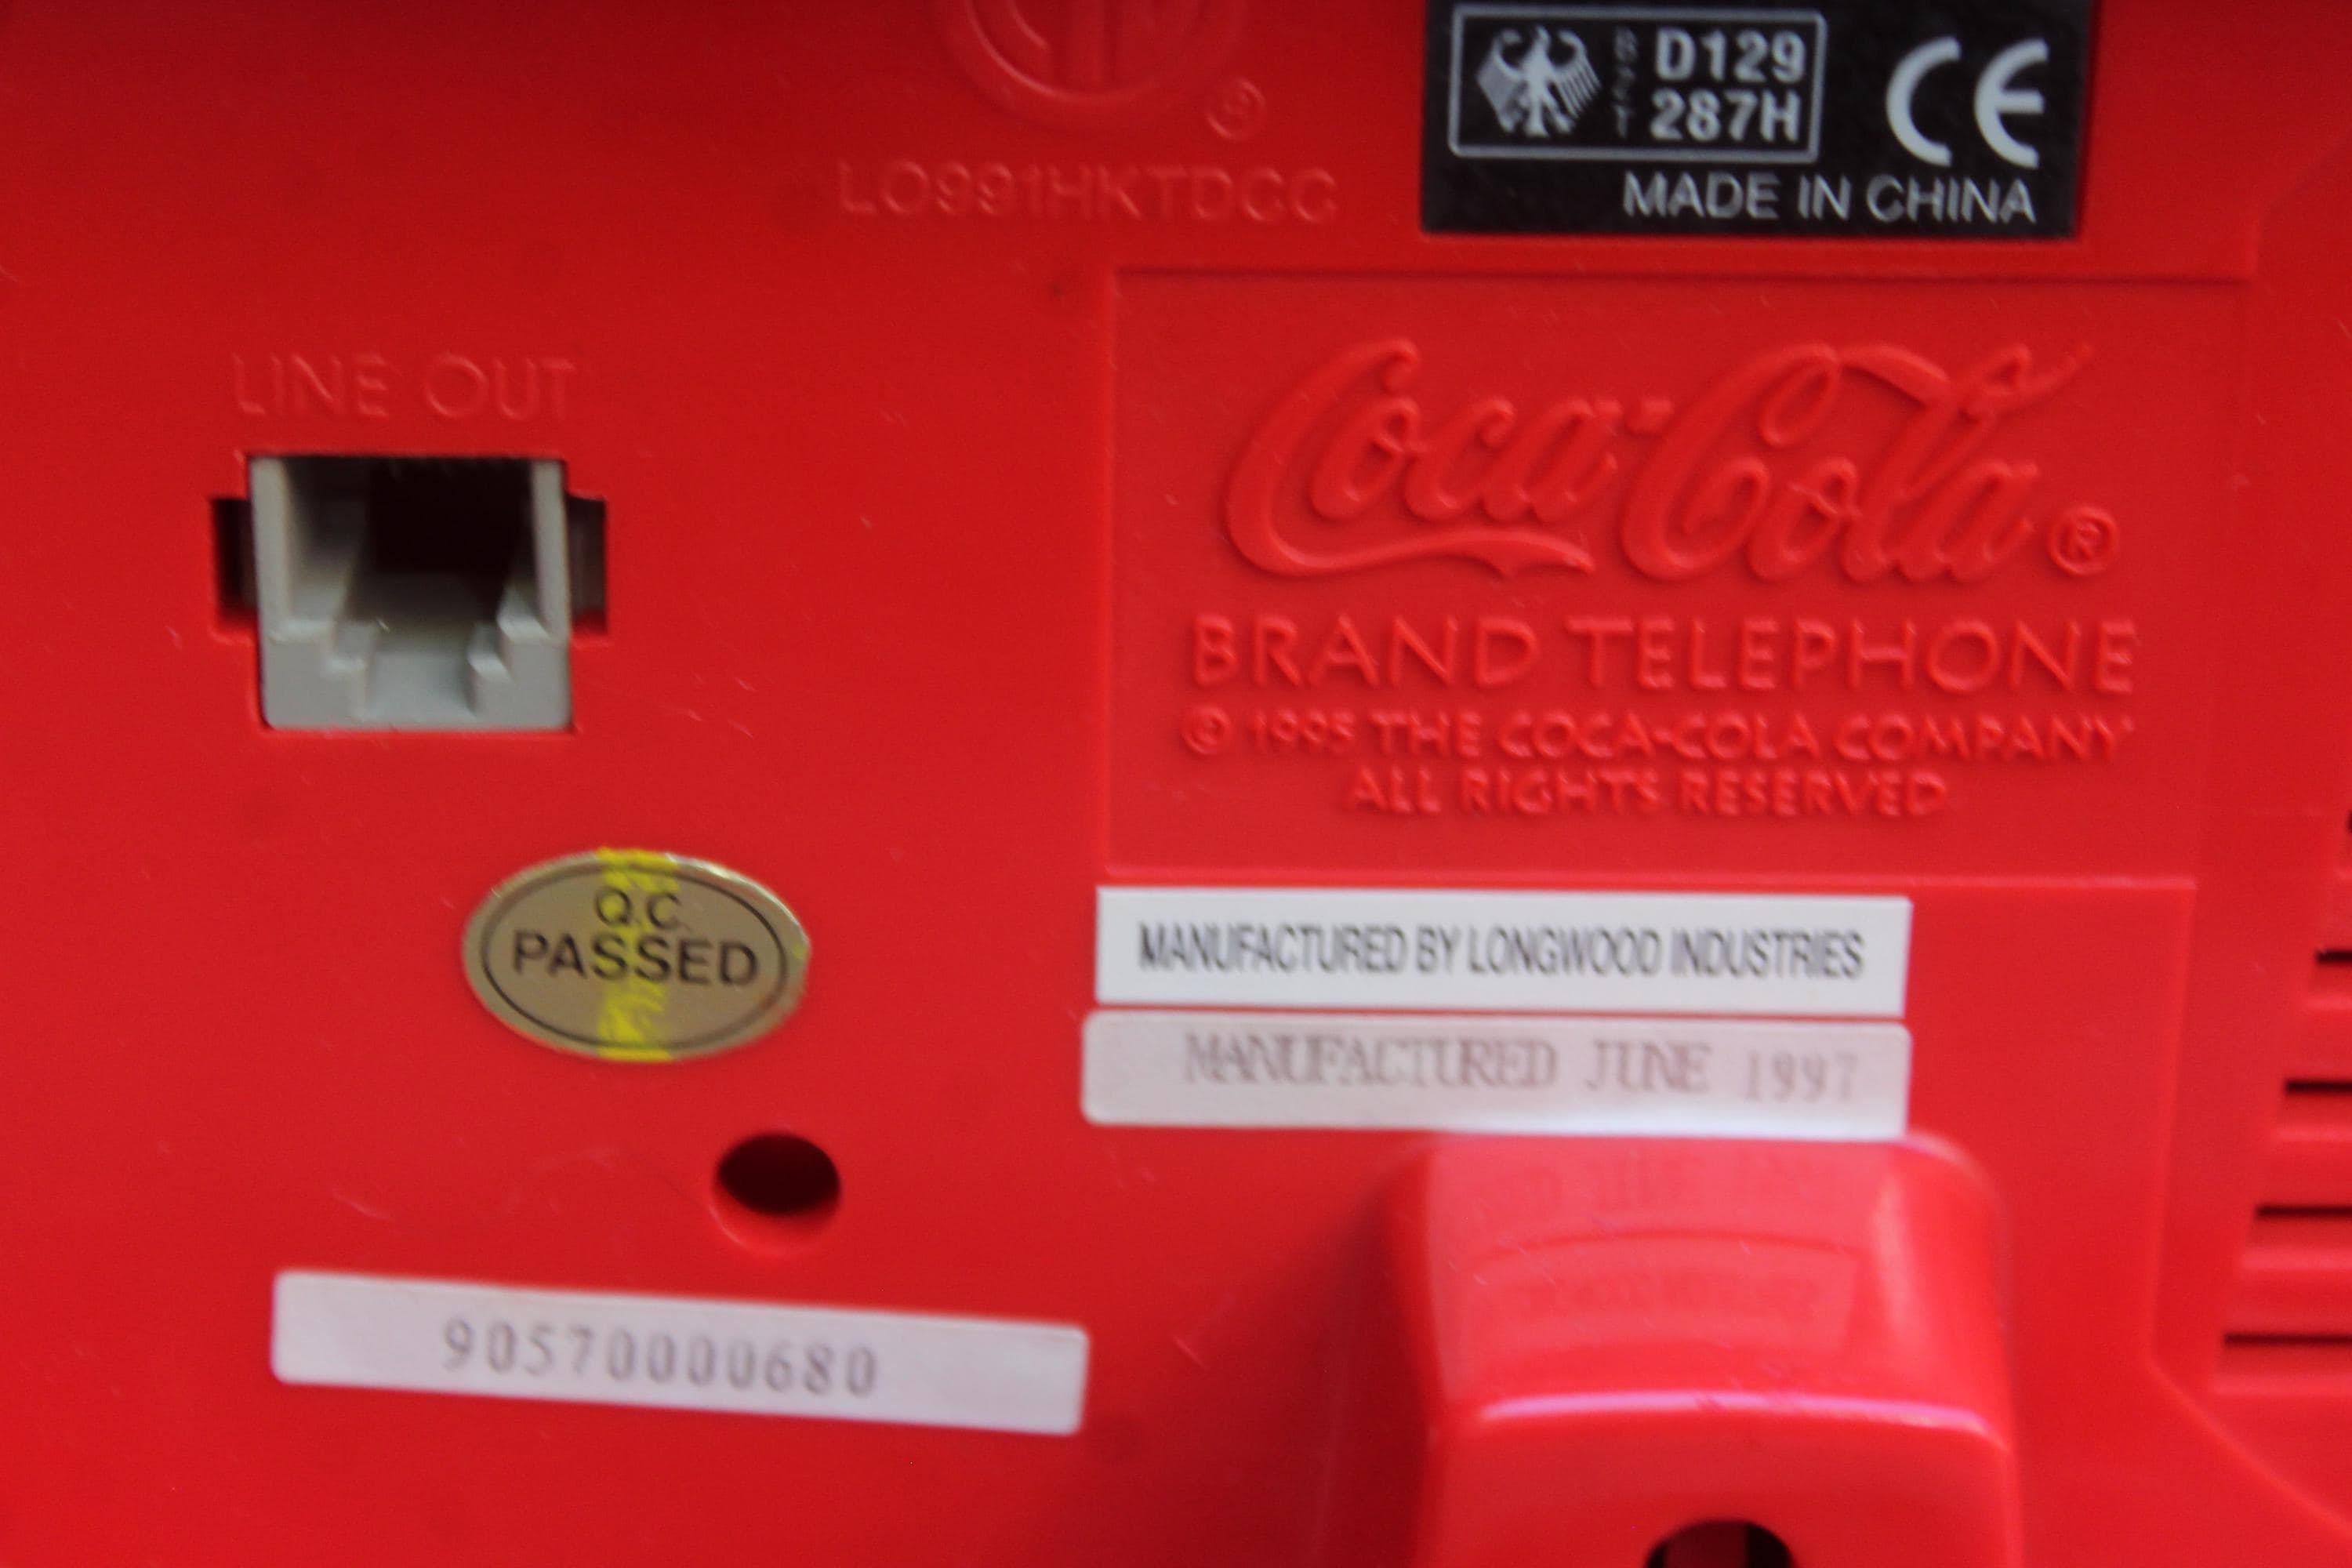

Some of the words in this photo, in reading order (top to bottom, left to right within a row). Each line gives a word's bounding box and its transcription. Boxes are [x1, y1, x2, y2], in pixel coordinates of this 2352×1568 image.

[1656, 27, 1806, 83] D129
[1650, 88, 1802, 142] 287H
[1886, 36, 2049, 168] CE
[1623, 171, 1779, 220] MADE
[1798, 174, 1852, 220] IN
[1867, 174, 2037, 223] CHINA
[234, 353, 389, 417] LINE
[423, 353, 574, 420] OUT
[1192, 613, 1541, 688] BRAND
[1568, 615, 2137, 696] TELEPHONE
[1250, 709, 1355, 754] 1995
[1366, 710, 1483, 757] THE
[1497, 712, 1820, 760] COCA-COLA
[1833, 713, 2134, 762] COMPANY
[1345, 767, 1443, 815] ALL
[1458, 768, 1661, 817] RIGHTS
[1678, 770, 1949, 818] RESERVED
[511, 931, 759, 986] PASSED
[1139, 922, 1406, 974] MANUFACTURED
[1417, 926, 1460, 975] BY
[1469, 927, 1662, 977] LONGWOOD
[1671, 928, 1864, 978] INDUSTRIES
[1185, 1033, 1557, 1090] MANUFACTURED
[1585, 1040, 1711, 1093] JUNE
[1744, 1052, 1860, 1101] 1997
[442, 1317, 878, 1397] 90570000680
